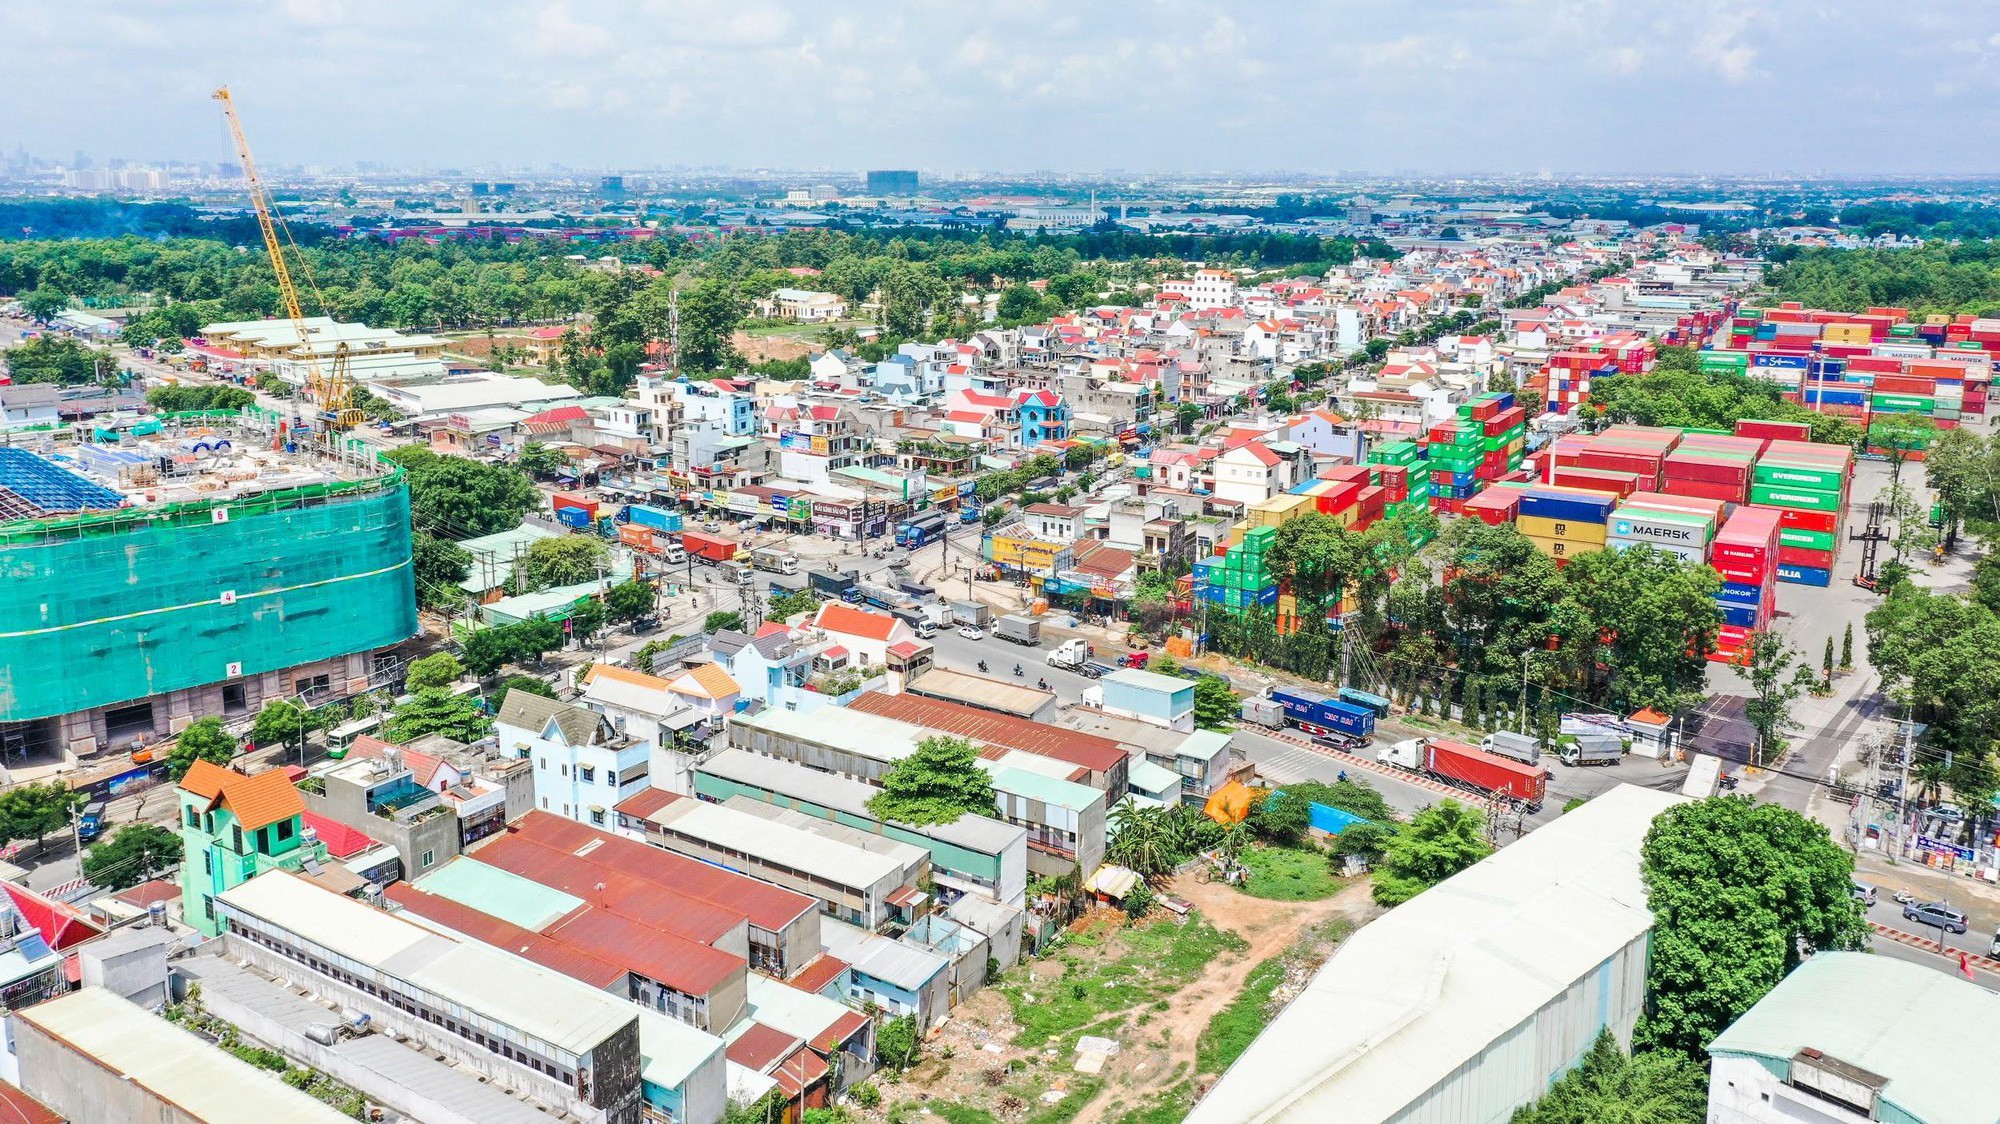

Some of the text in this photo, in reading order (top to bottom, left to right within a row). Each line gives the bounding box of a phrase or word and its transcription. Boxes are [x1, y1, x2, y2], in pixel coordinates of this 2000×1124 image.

[1772, 472, 1822, 483] EVERGREEN
[1769, 493, 1819, 504] EVERGREEN
[218, 511, 224, 521] 6
[1633, 525, 1690, 540] MAERSK
[225, 592, 232, 602] 4
[230, 663, 238, 674] 2
